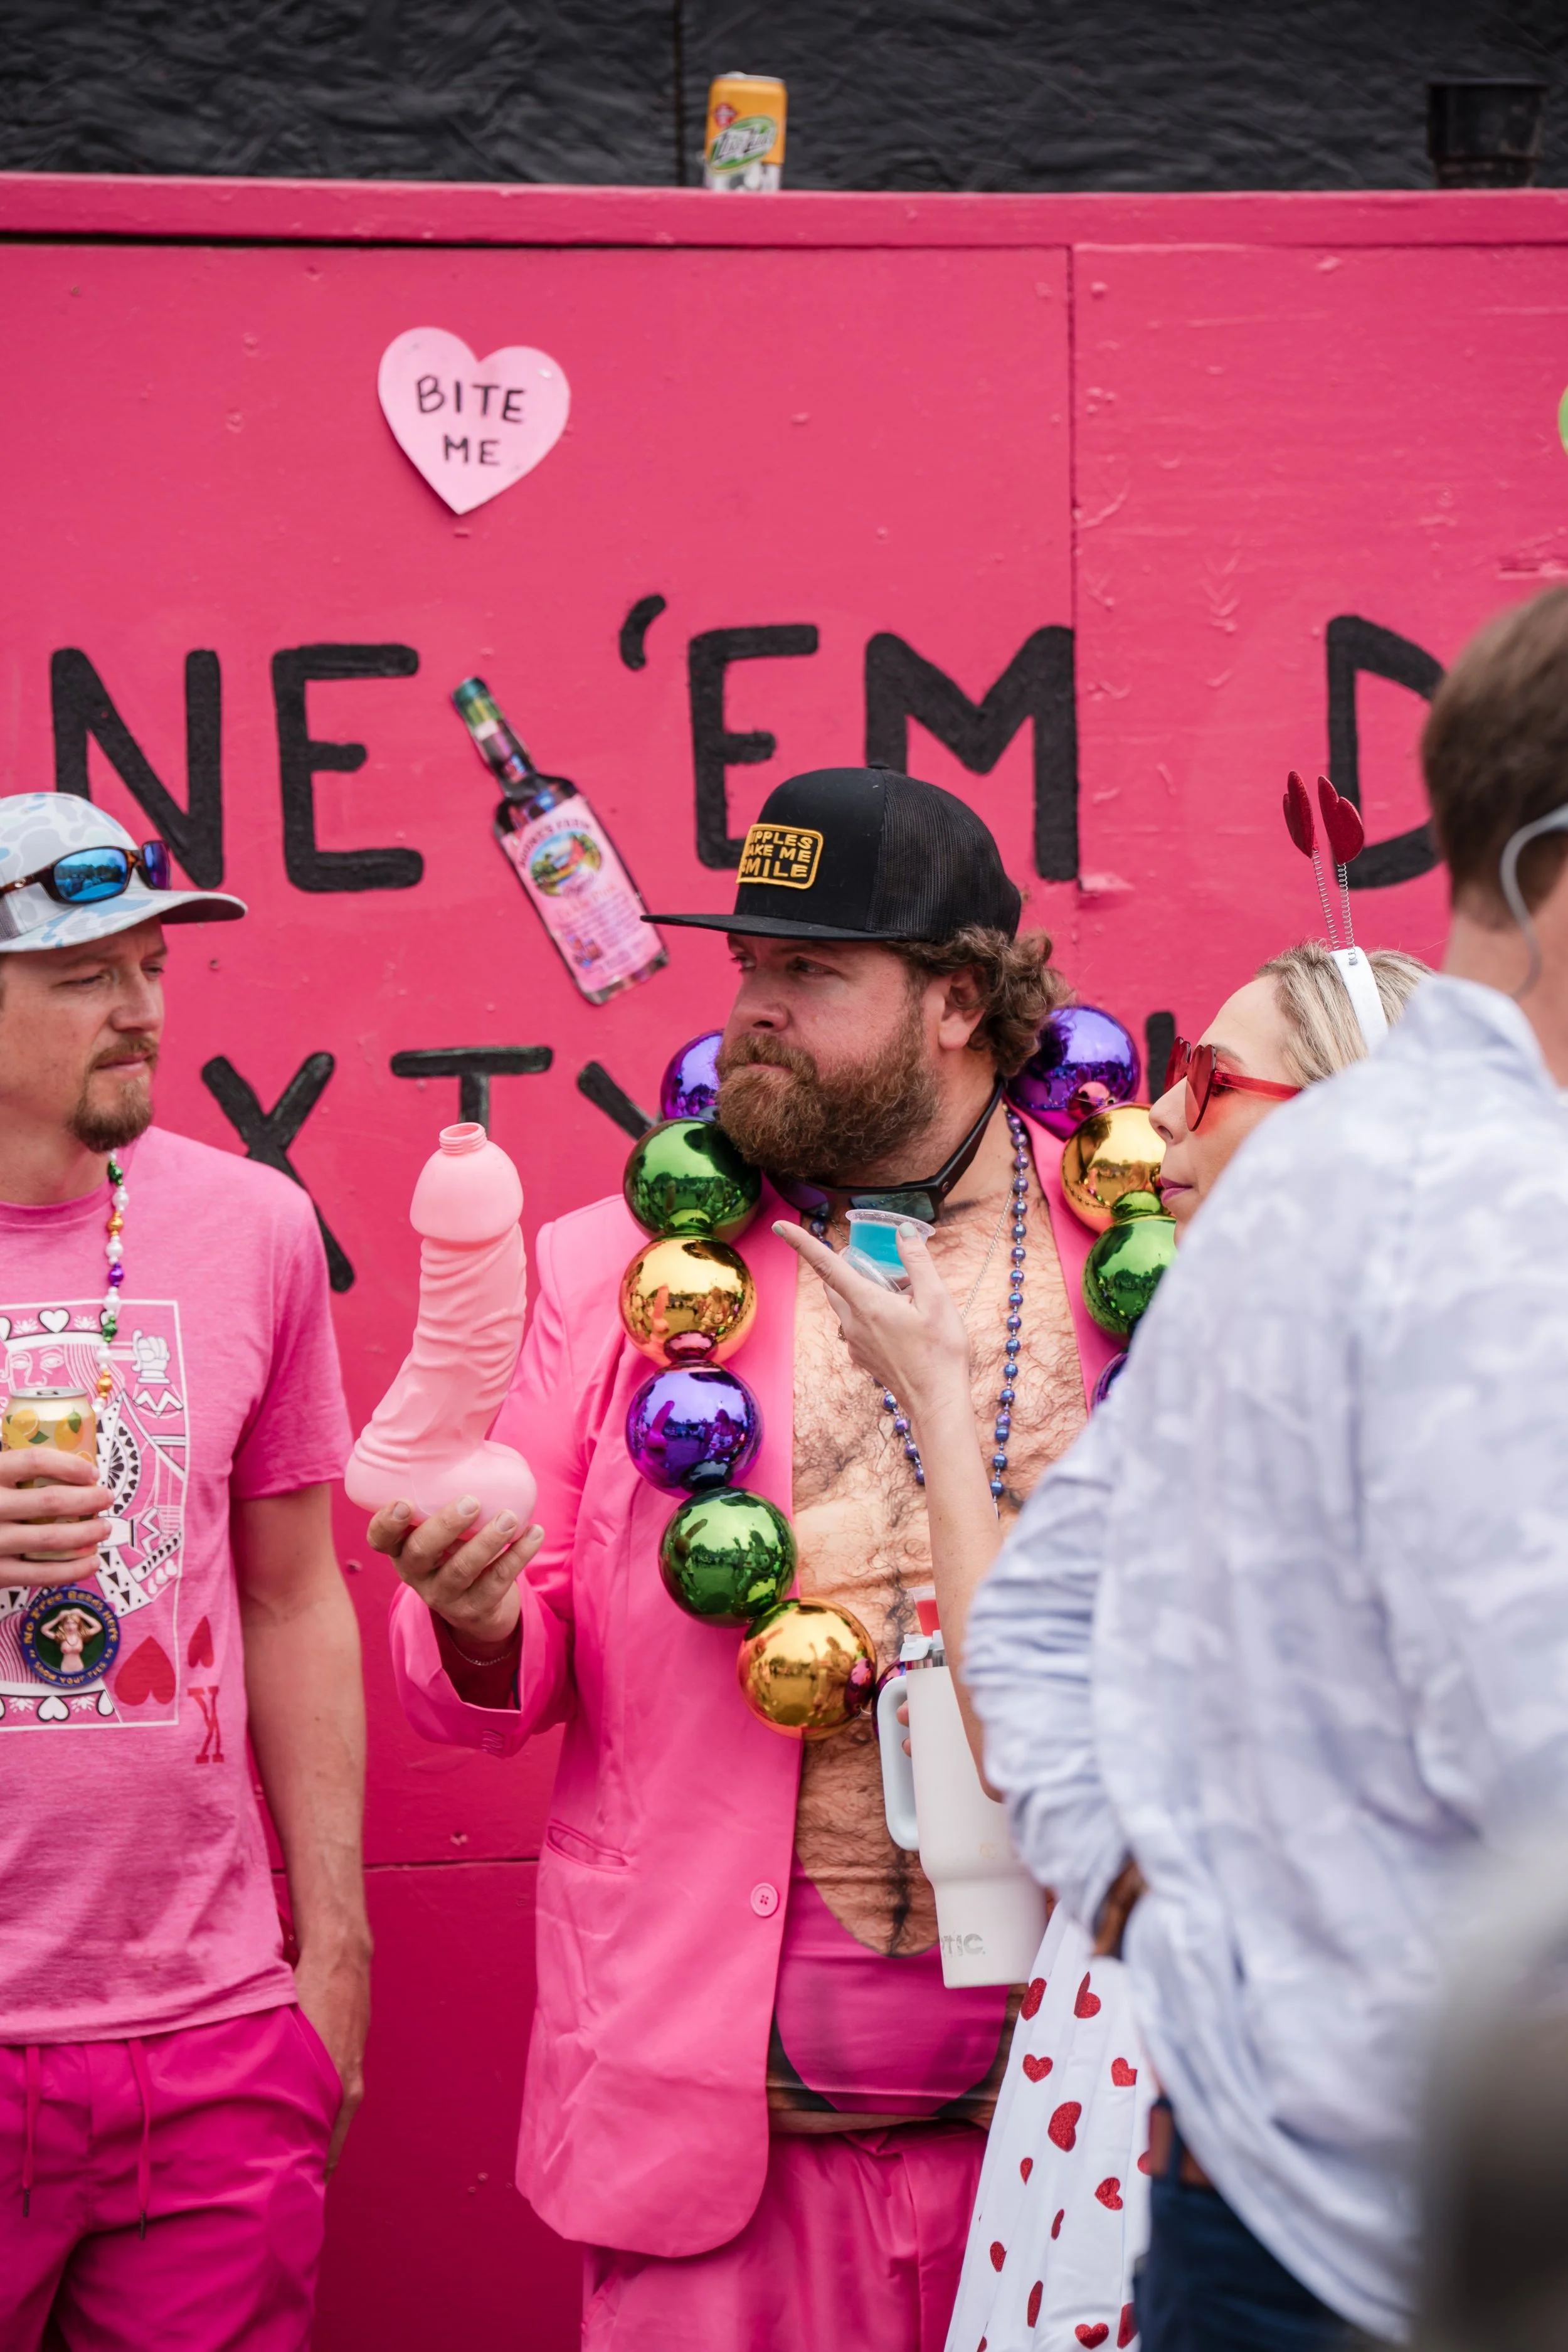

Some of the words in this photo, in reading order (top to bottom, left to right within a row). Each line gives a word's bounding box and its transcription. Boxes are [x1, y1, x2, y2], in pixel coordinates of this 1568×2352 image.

[416, 374, 526, 423] BITE
[443, 433, 501, 466] ME
[779, 847, 812, 864] ME
